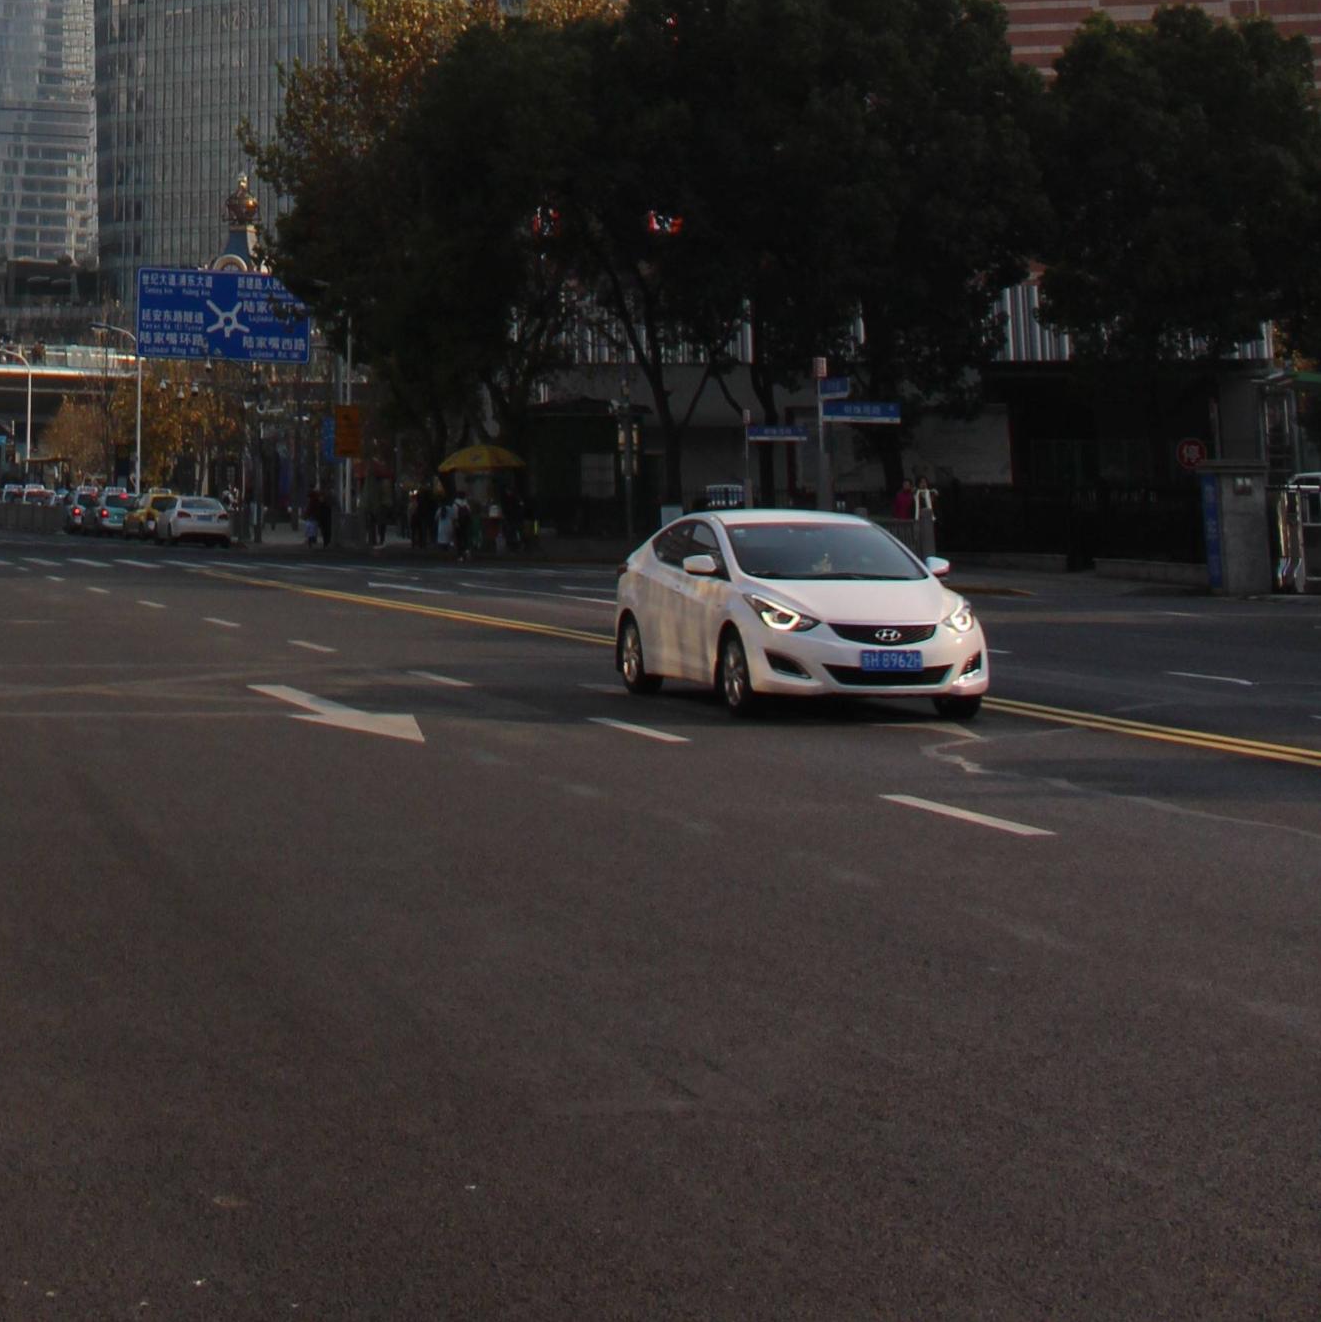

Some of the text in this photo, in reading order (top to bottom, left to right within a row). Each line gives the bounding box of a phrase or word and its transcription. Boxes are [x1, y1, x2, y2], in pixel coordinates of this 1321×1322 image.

[142, 273, 176, 286] 世纪大道
[142, 308, 204, 324] 延安东路隧道
[139, 331, 203, 346] 陆家嘴环路
[242, 336, 306, 350] 陆家嘴西路
